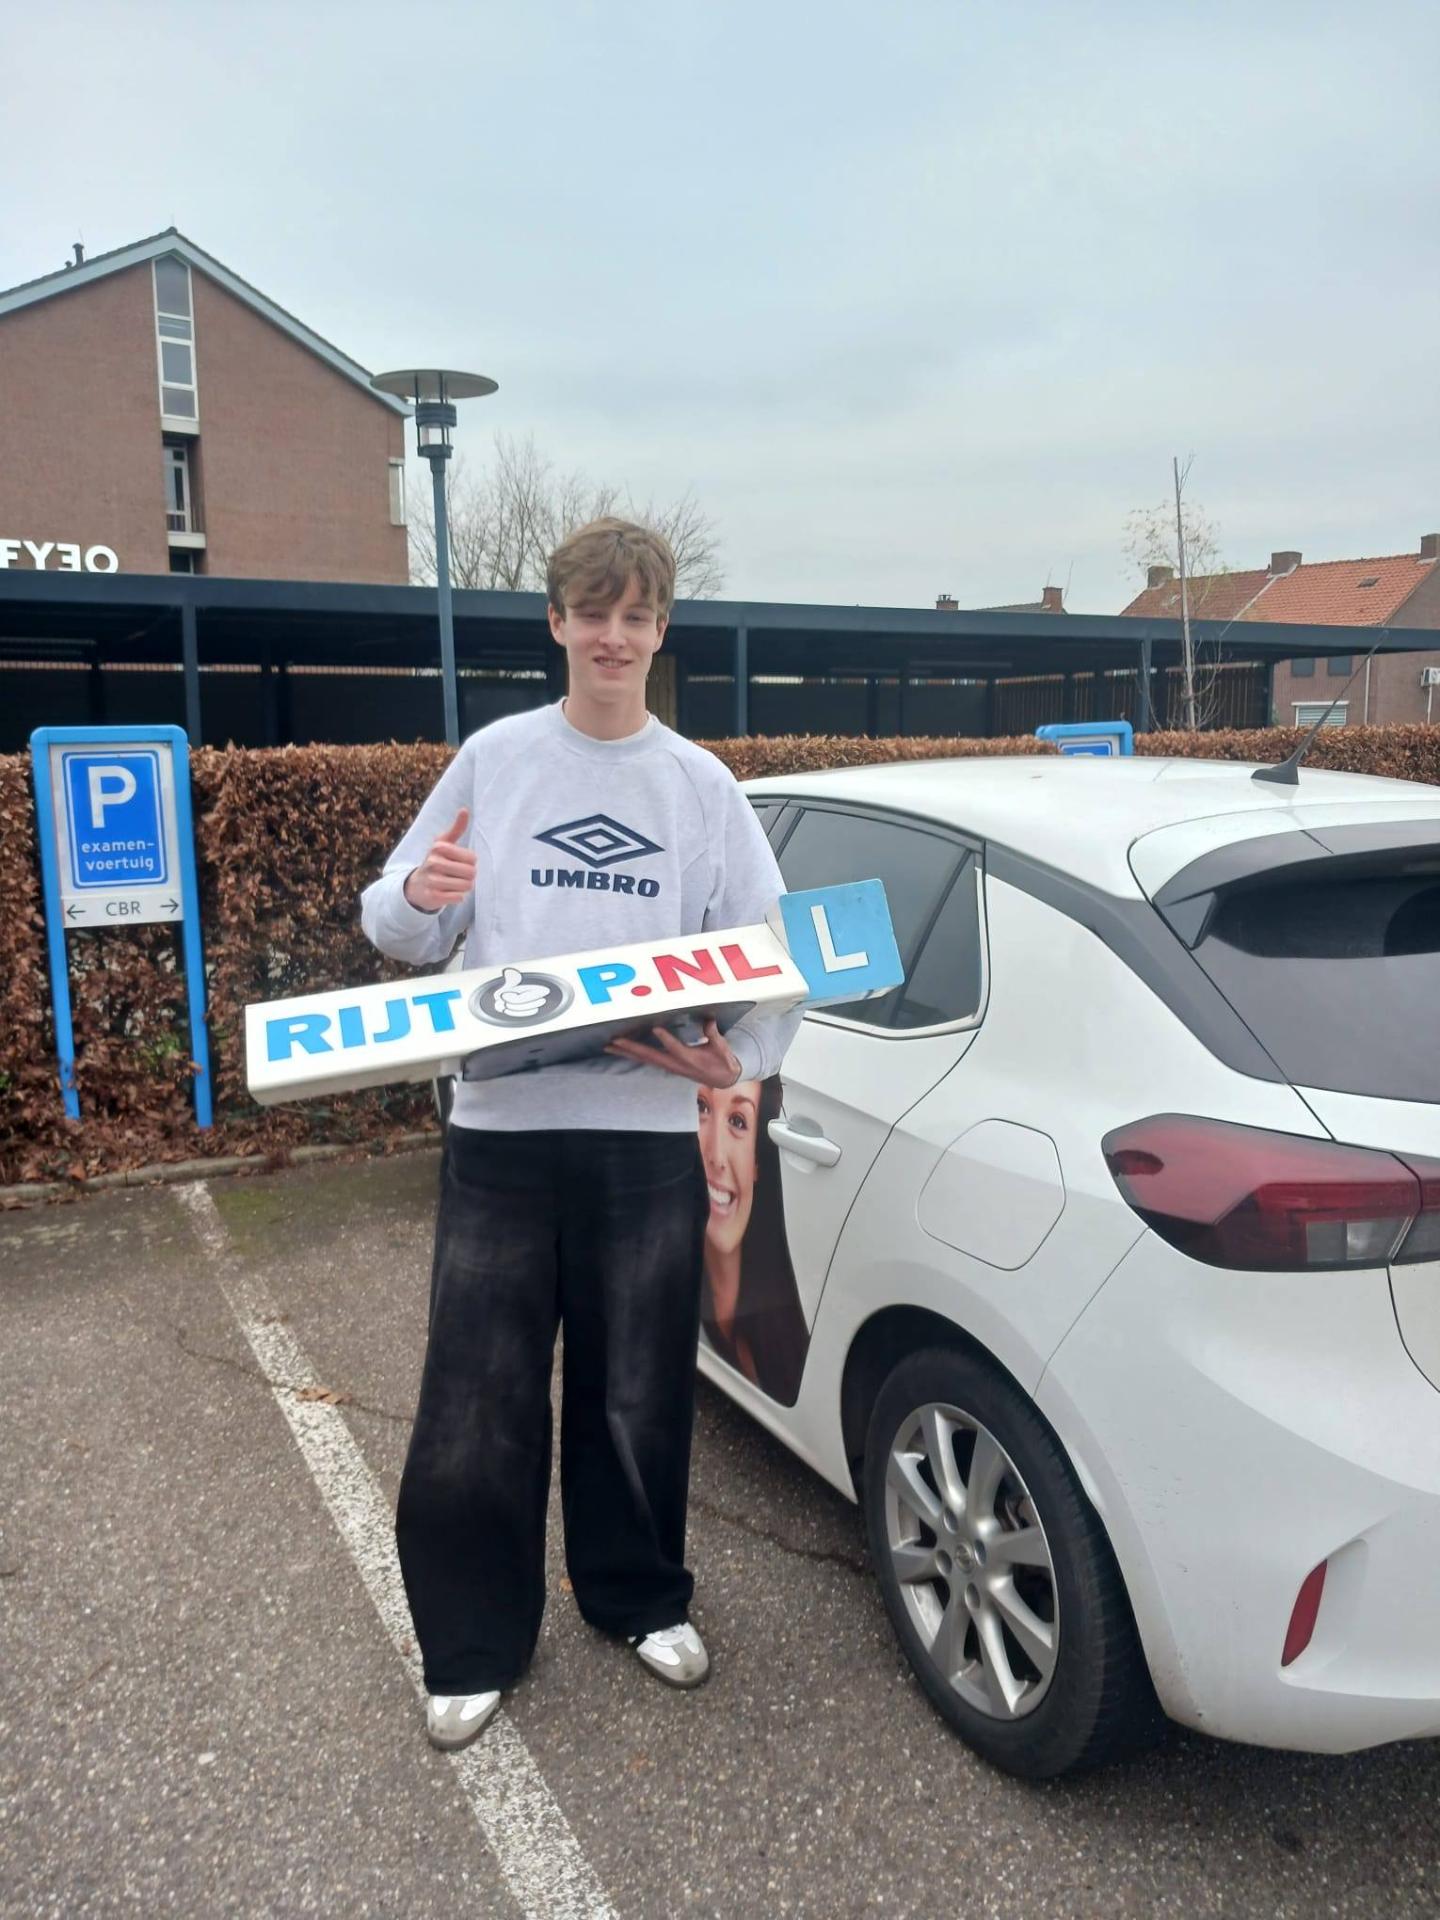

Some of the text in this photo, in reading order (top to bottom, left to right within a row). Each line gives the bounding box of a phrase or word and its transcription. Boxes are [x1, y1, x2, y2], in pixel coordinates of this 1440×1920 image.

[87, 765, 136, 828] P
[81, 839, 155, 853] examen-
[85, 855, 155, 871] voertuig
[531, 868, 661, 898] UMBRO
[105, 900, 142, 917] CBR
[810, 904, 869, 974] L
